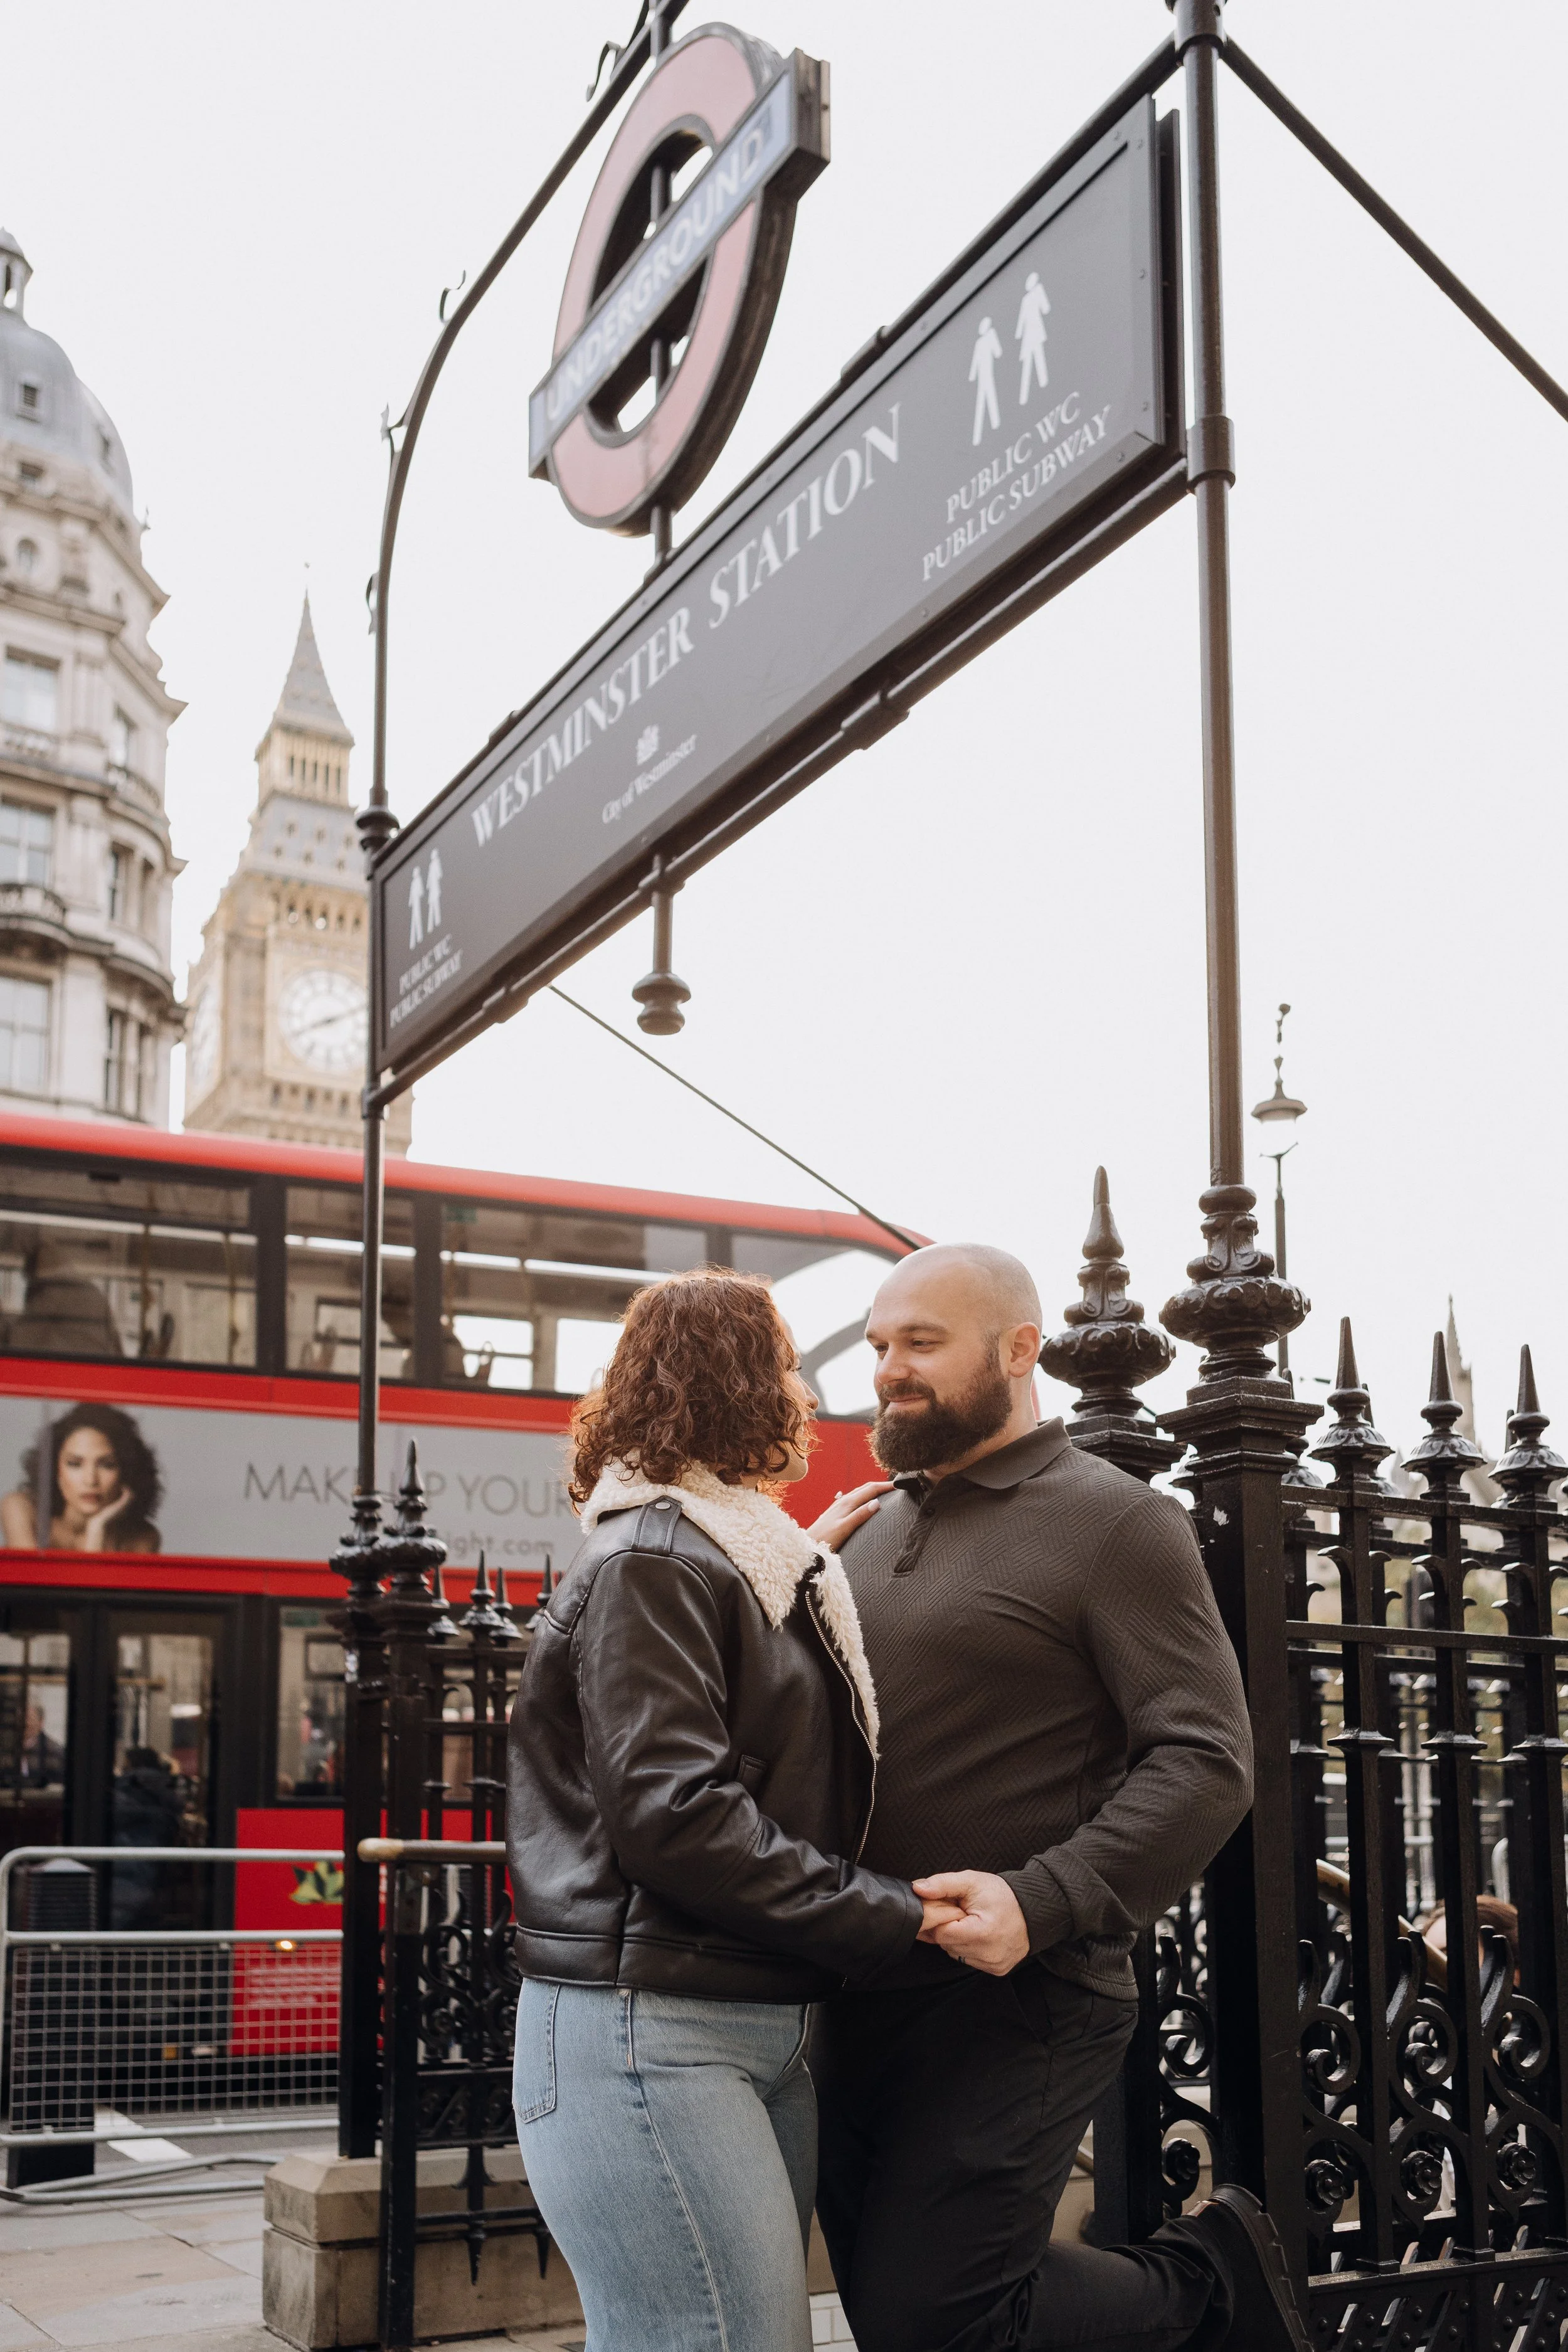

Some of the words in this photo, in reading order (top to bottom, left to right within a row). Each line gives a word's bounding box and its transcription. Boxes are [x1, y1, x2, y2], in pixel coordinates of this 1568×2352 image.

[544, 125, 767, 422] UNDERGROUND
[922, 497, 1006, 582] PUBLIC
[1009, 404, 1112, 511] SUBWAY
[946, 432, 1032, 523] PUBLIC
[1035, 391, 1081, 444] WC
[470, 606, 695, 848] WESTMINSTER
[708, 401, 902, 629] STATION
[243, 1461, 371, 1507] MAK
